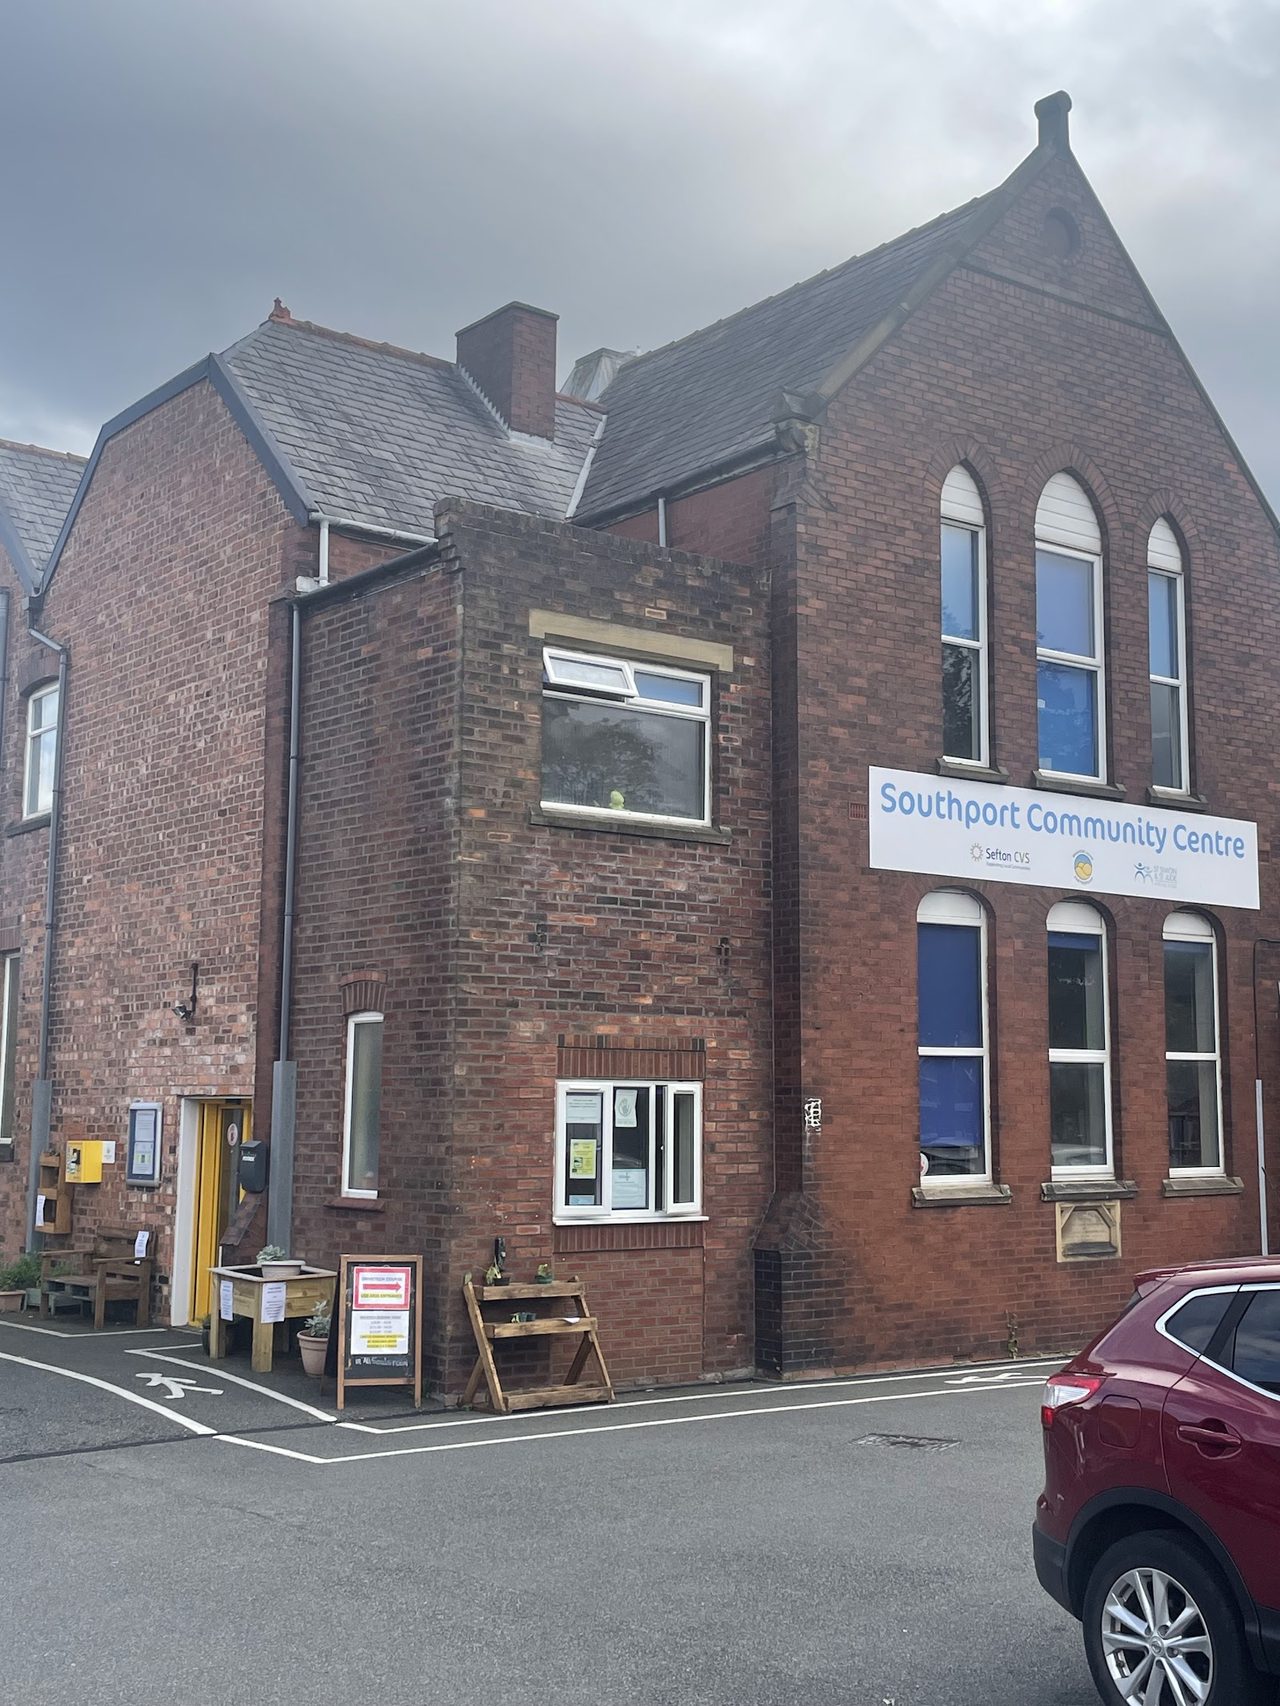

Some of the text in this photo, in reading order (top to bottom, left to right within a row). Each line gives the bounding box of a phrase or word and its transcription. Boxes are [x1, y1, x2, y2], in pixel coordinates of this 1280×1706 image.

[880, 782, 1245, 859] Southport Community Centre
[985, 847, 1031, 864] Sefton CVS
